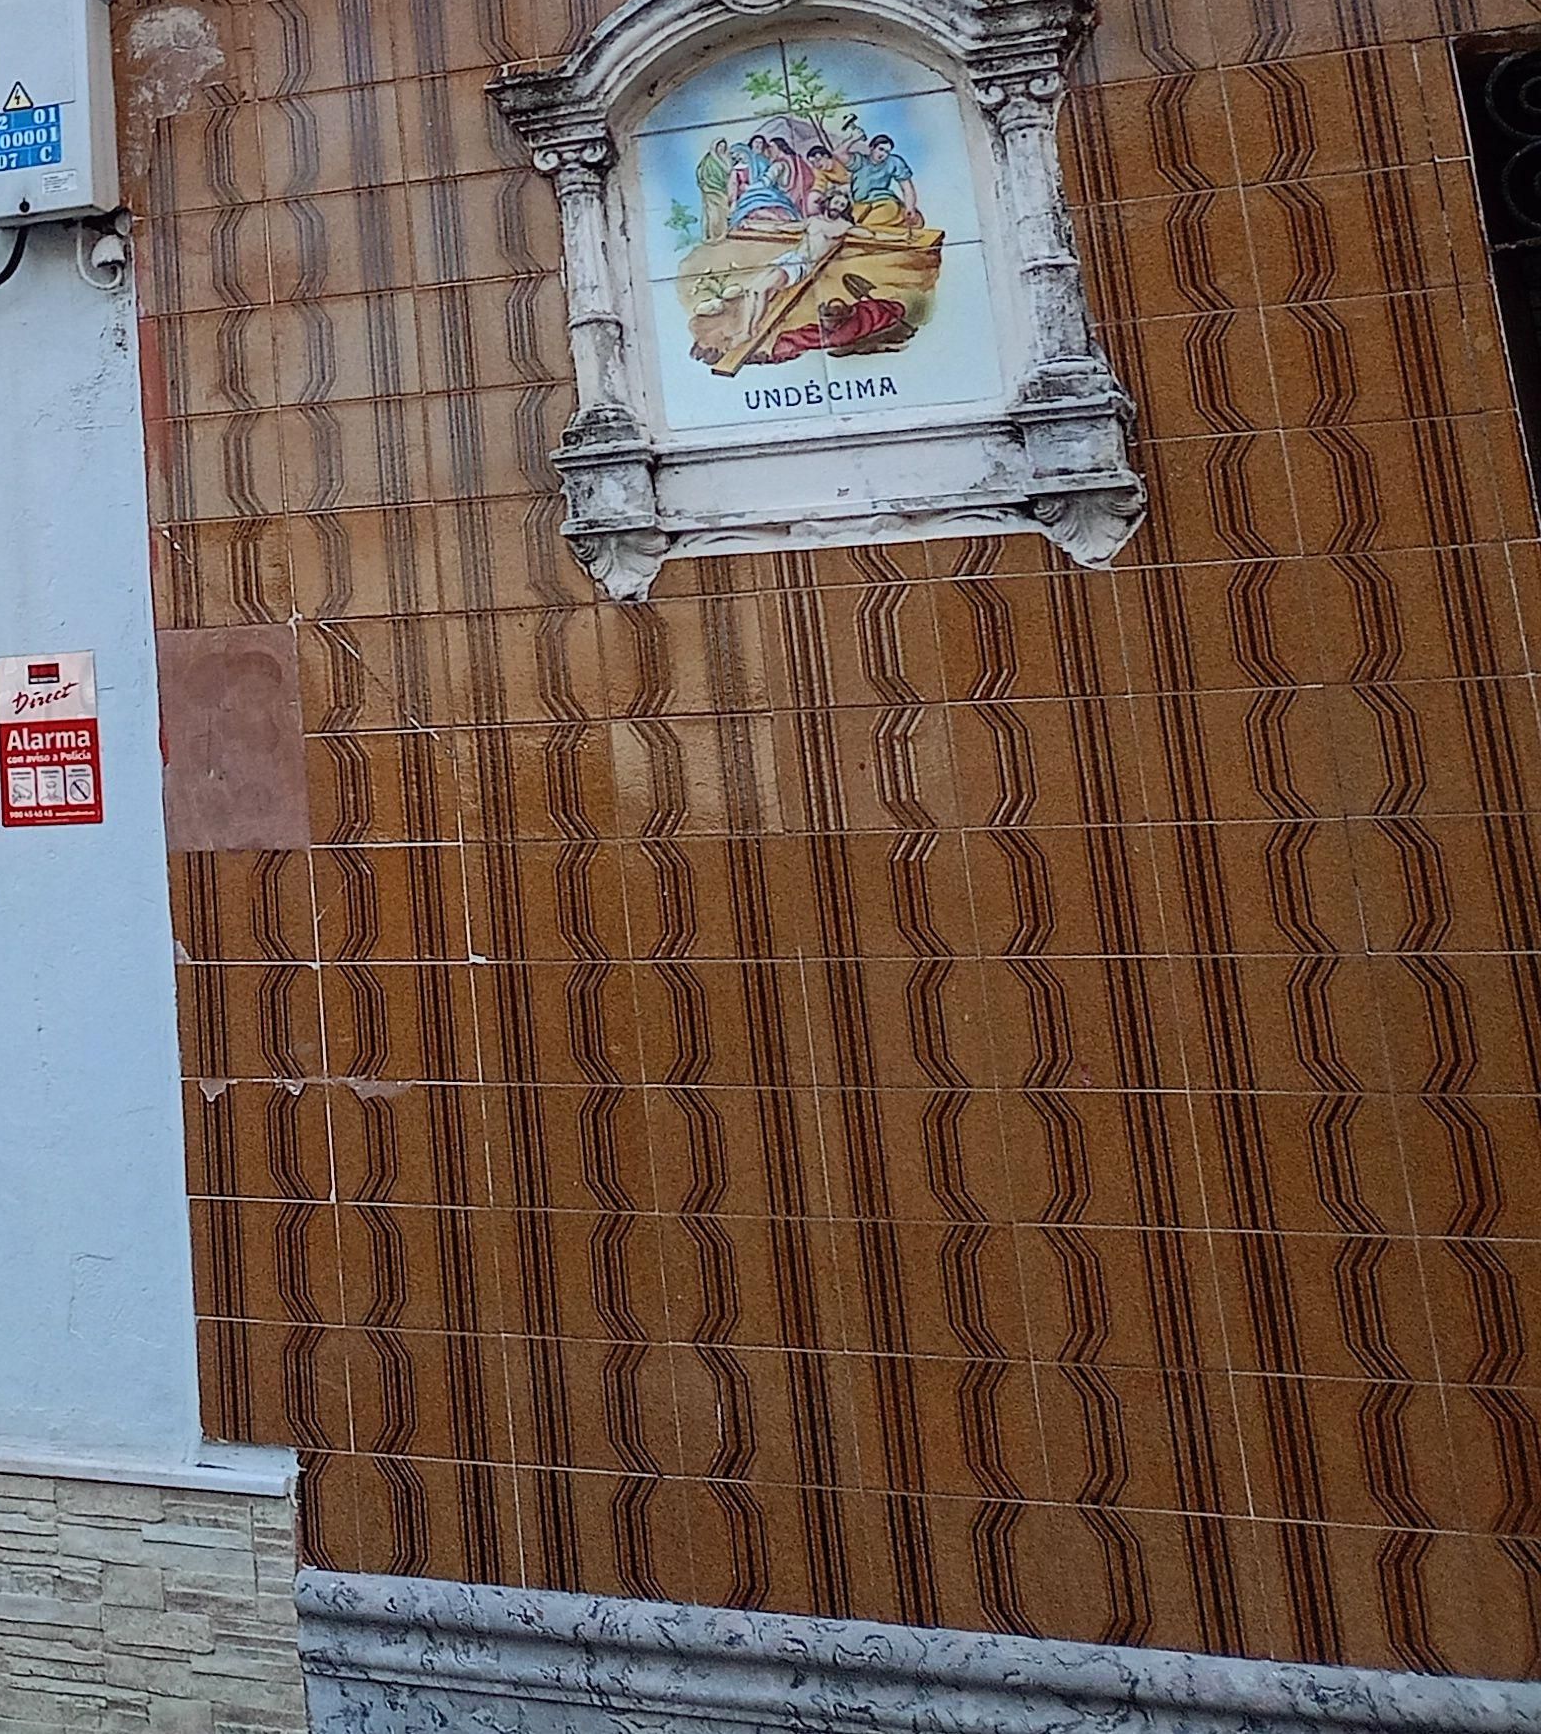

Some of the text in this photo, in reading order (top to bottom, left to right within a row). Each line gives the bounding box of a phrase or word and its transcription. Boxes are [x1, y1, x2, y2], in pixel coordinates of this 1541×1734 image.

[33, 107, 56, 124] 01
[0, 126, 58, 150] 00001
[39, 146, 53, 163] C
[12, 681, 80, 715] Direct
[6, 727, 91, 752] Alarma
[6, 756, 24, 764] con
[25, 752, 50, 763] aviso
[52, 753, 59, 762] a
